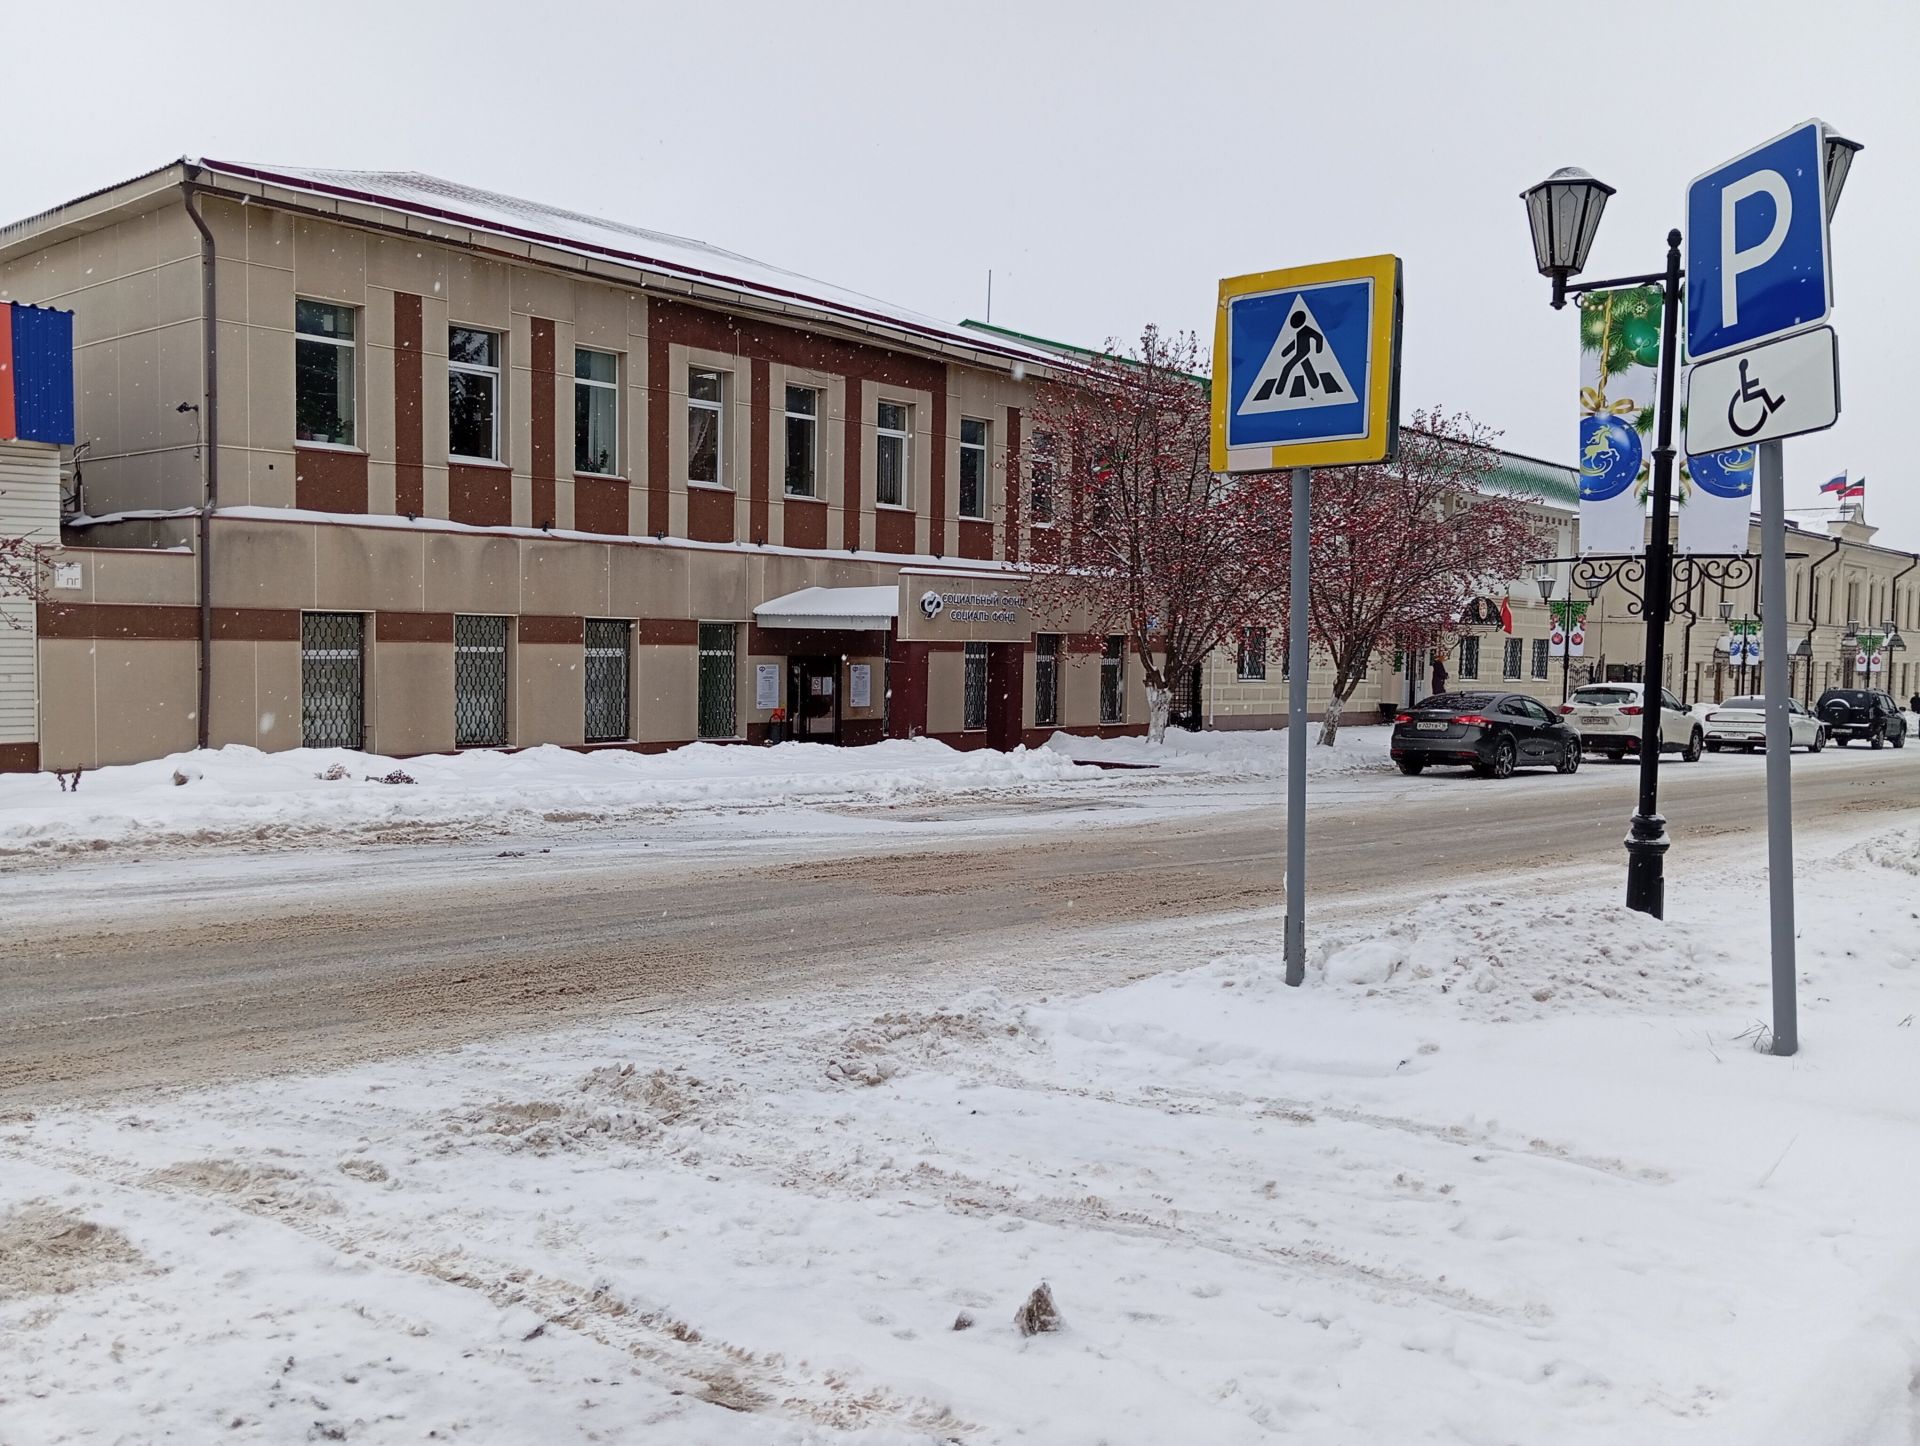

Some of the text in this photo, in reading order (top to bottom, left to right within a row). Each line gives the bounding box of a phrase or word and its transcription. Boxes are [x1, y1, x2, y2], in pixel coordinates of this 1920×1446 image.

[1721, 169, 1792, 328] P
[942, 593, 1026, 608] СОЦИАЛЬНЫЙ ФОНД
[950, 609, 1016, 624] СОЦИАЛЬ ФОНД
